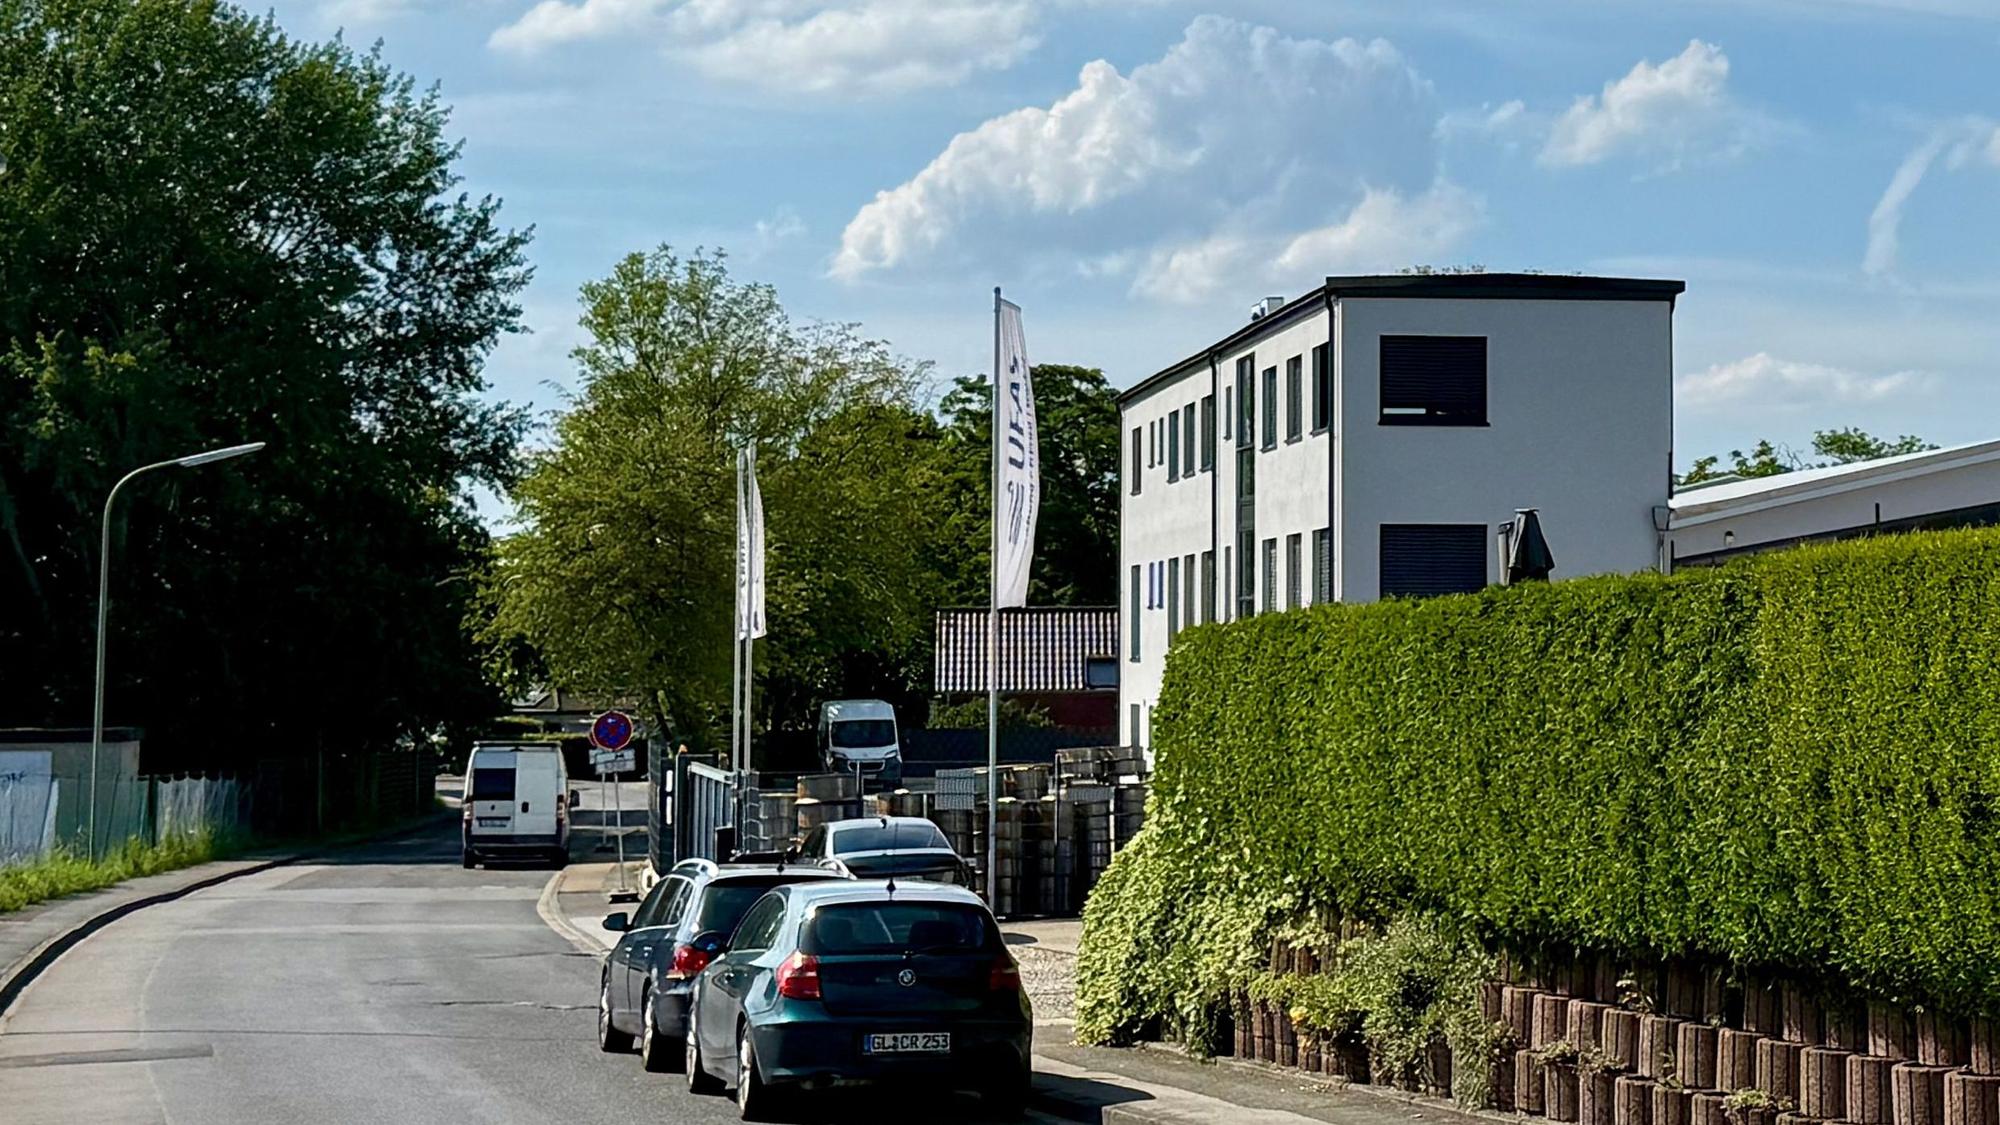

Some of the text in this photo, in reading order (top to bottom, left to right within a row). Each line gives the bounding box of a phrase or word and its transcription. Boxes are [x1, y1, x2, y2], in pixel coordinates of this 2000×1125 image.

[872, 1034, 948, 1049] GL CR 253
